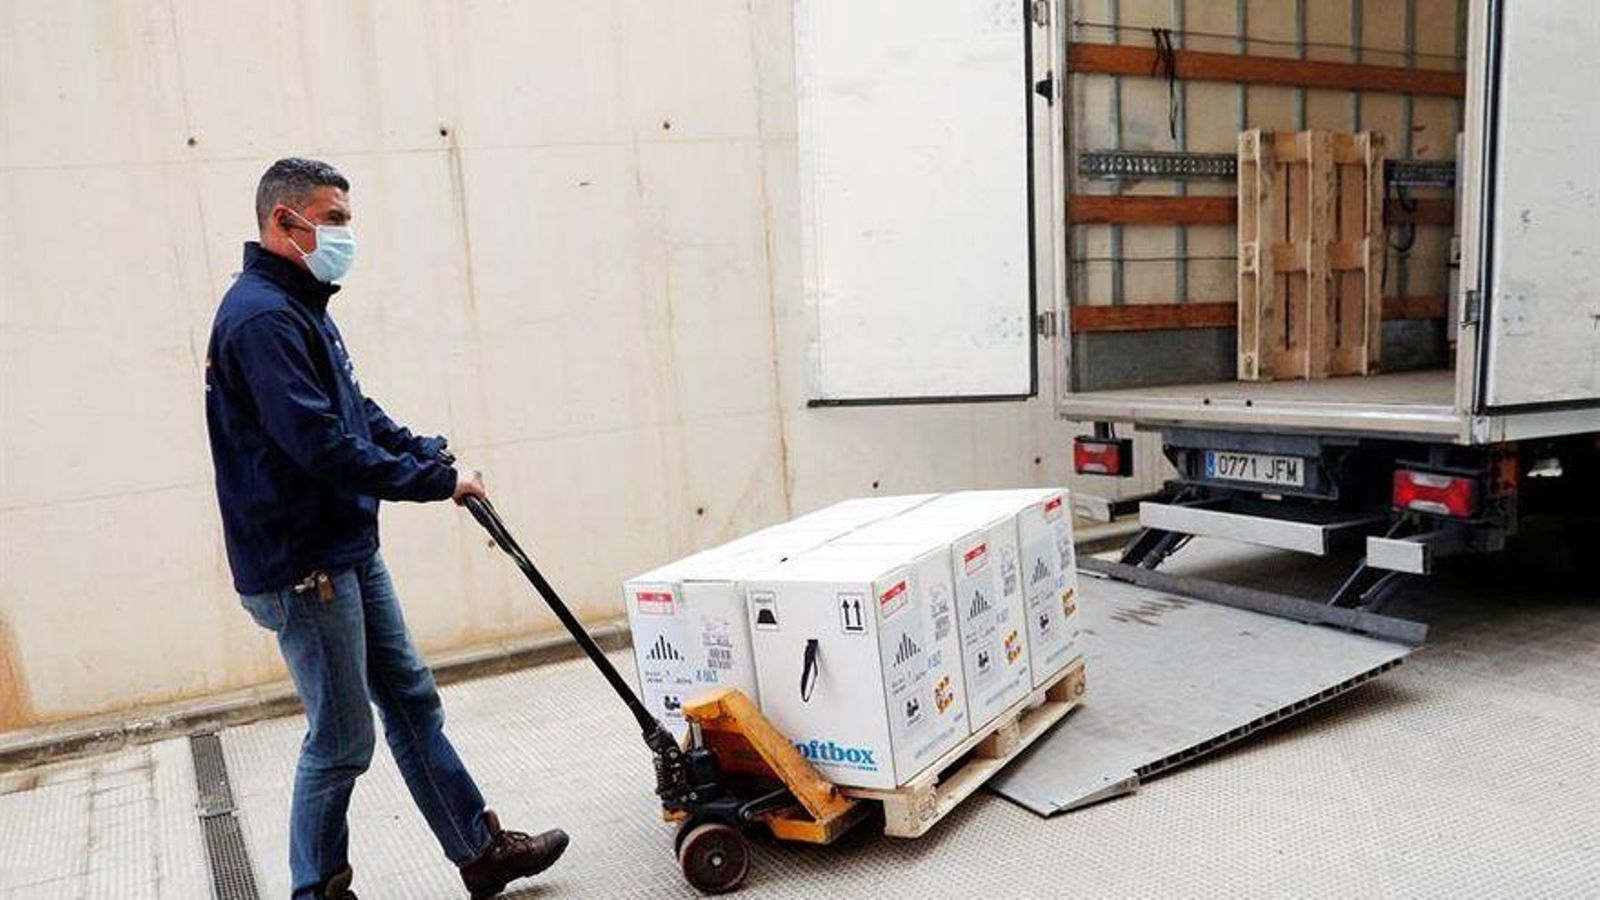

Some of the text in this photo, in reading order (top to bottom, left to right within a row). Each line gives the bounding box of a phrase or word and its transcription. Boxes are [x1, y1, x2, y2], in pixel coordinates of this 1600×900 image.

[1219, 454, 1298, 482] 0771 JFM
[794, 739, 876, 765] oftbox
